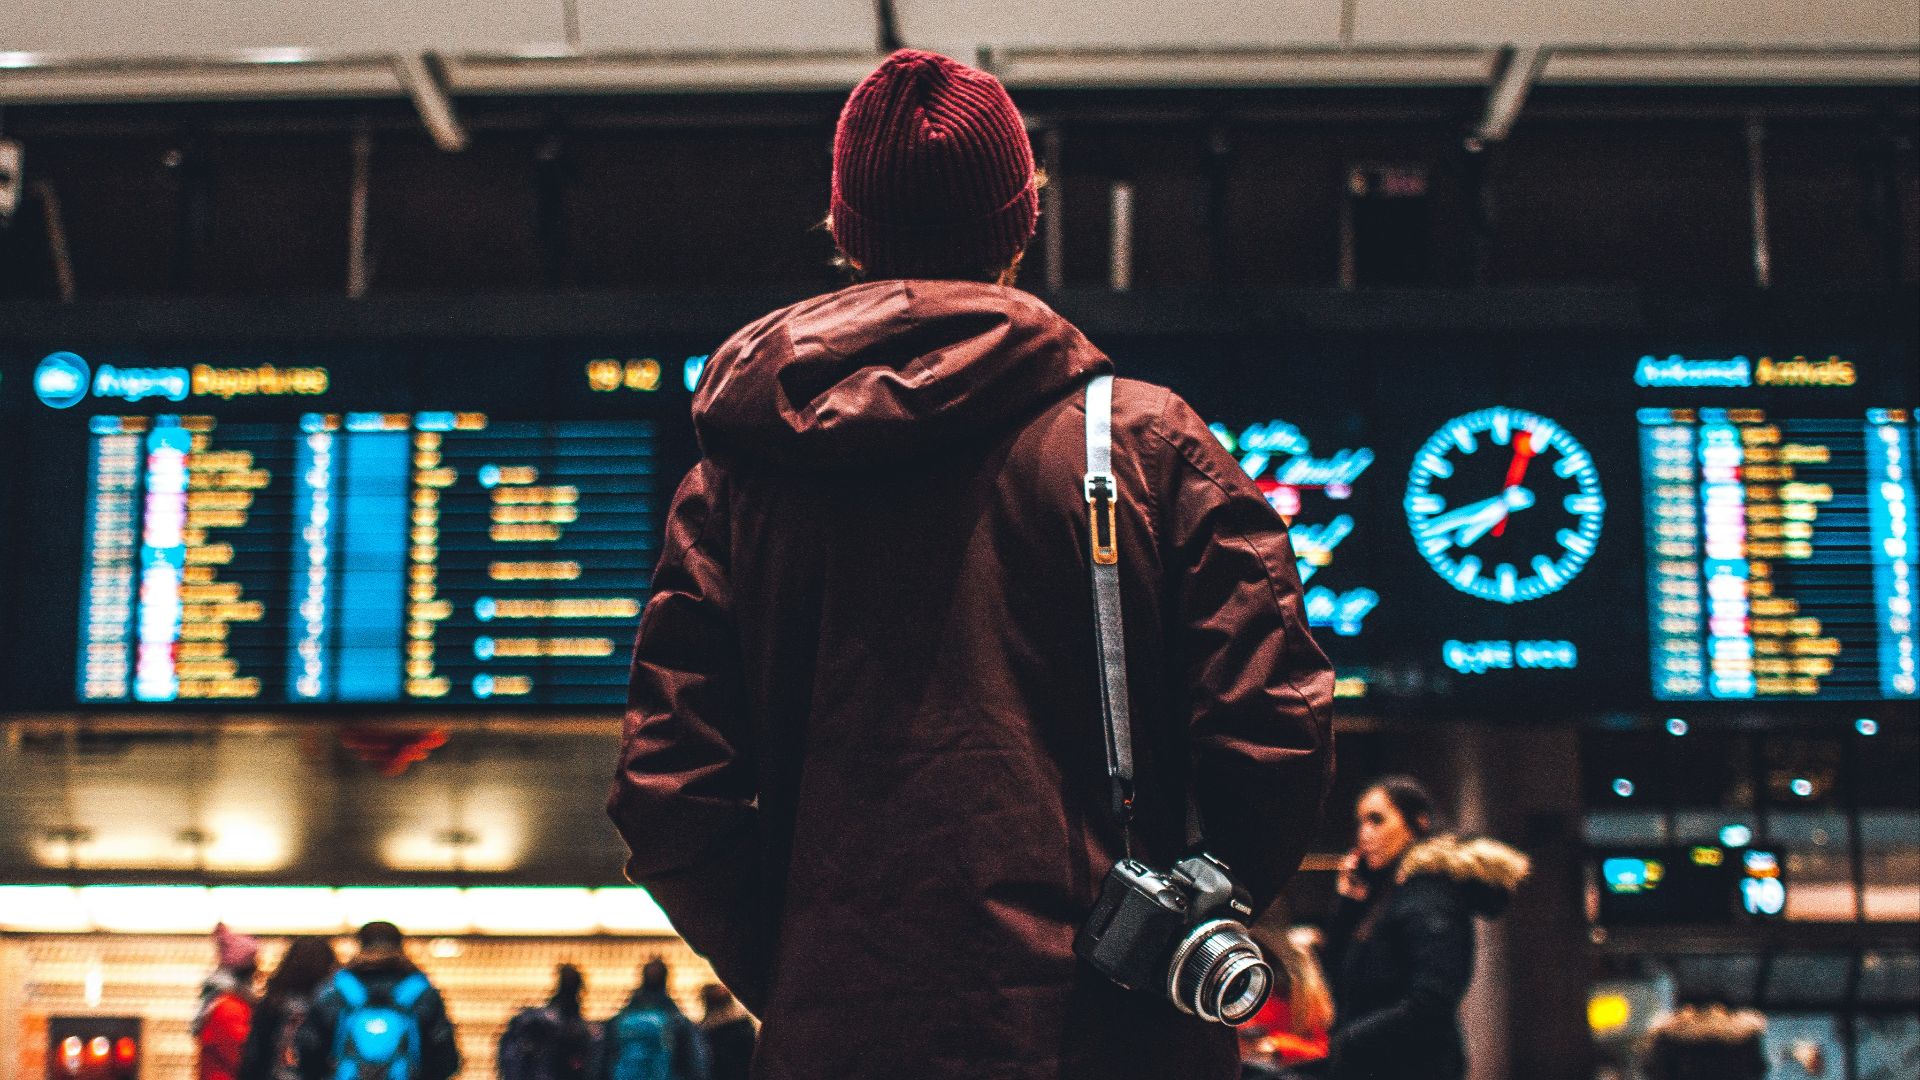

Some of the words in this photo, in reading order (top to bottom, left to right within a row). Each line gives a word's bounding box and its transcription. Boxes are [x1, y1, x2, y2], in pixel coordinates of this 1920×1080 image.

[192, 364, 330, 399] Departures
[1755, 356, 1856, 387] Arrivals
[1230, 899, 1252, 916] Canon
